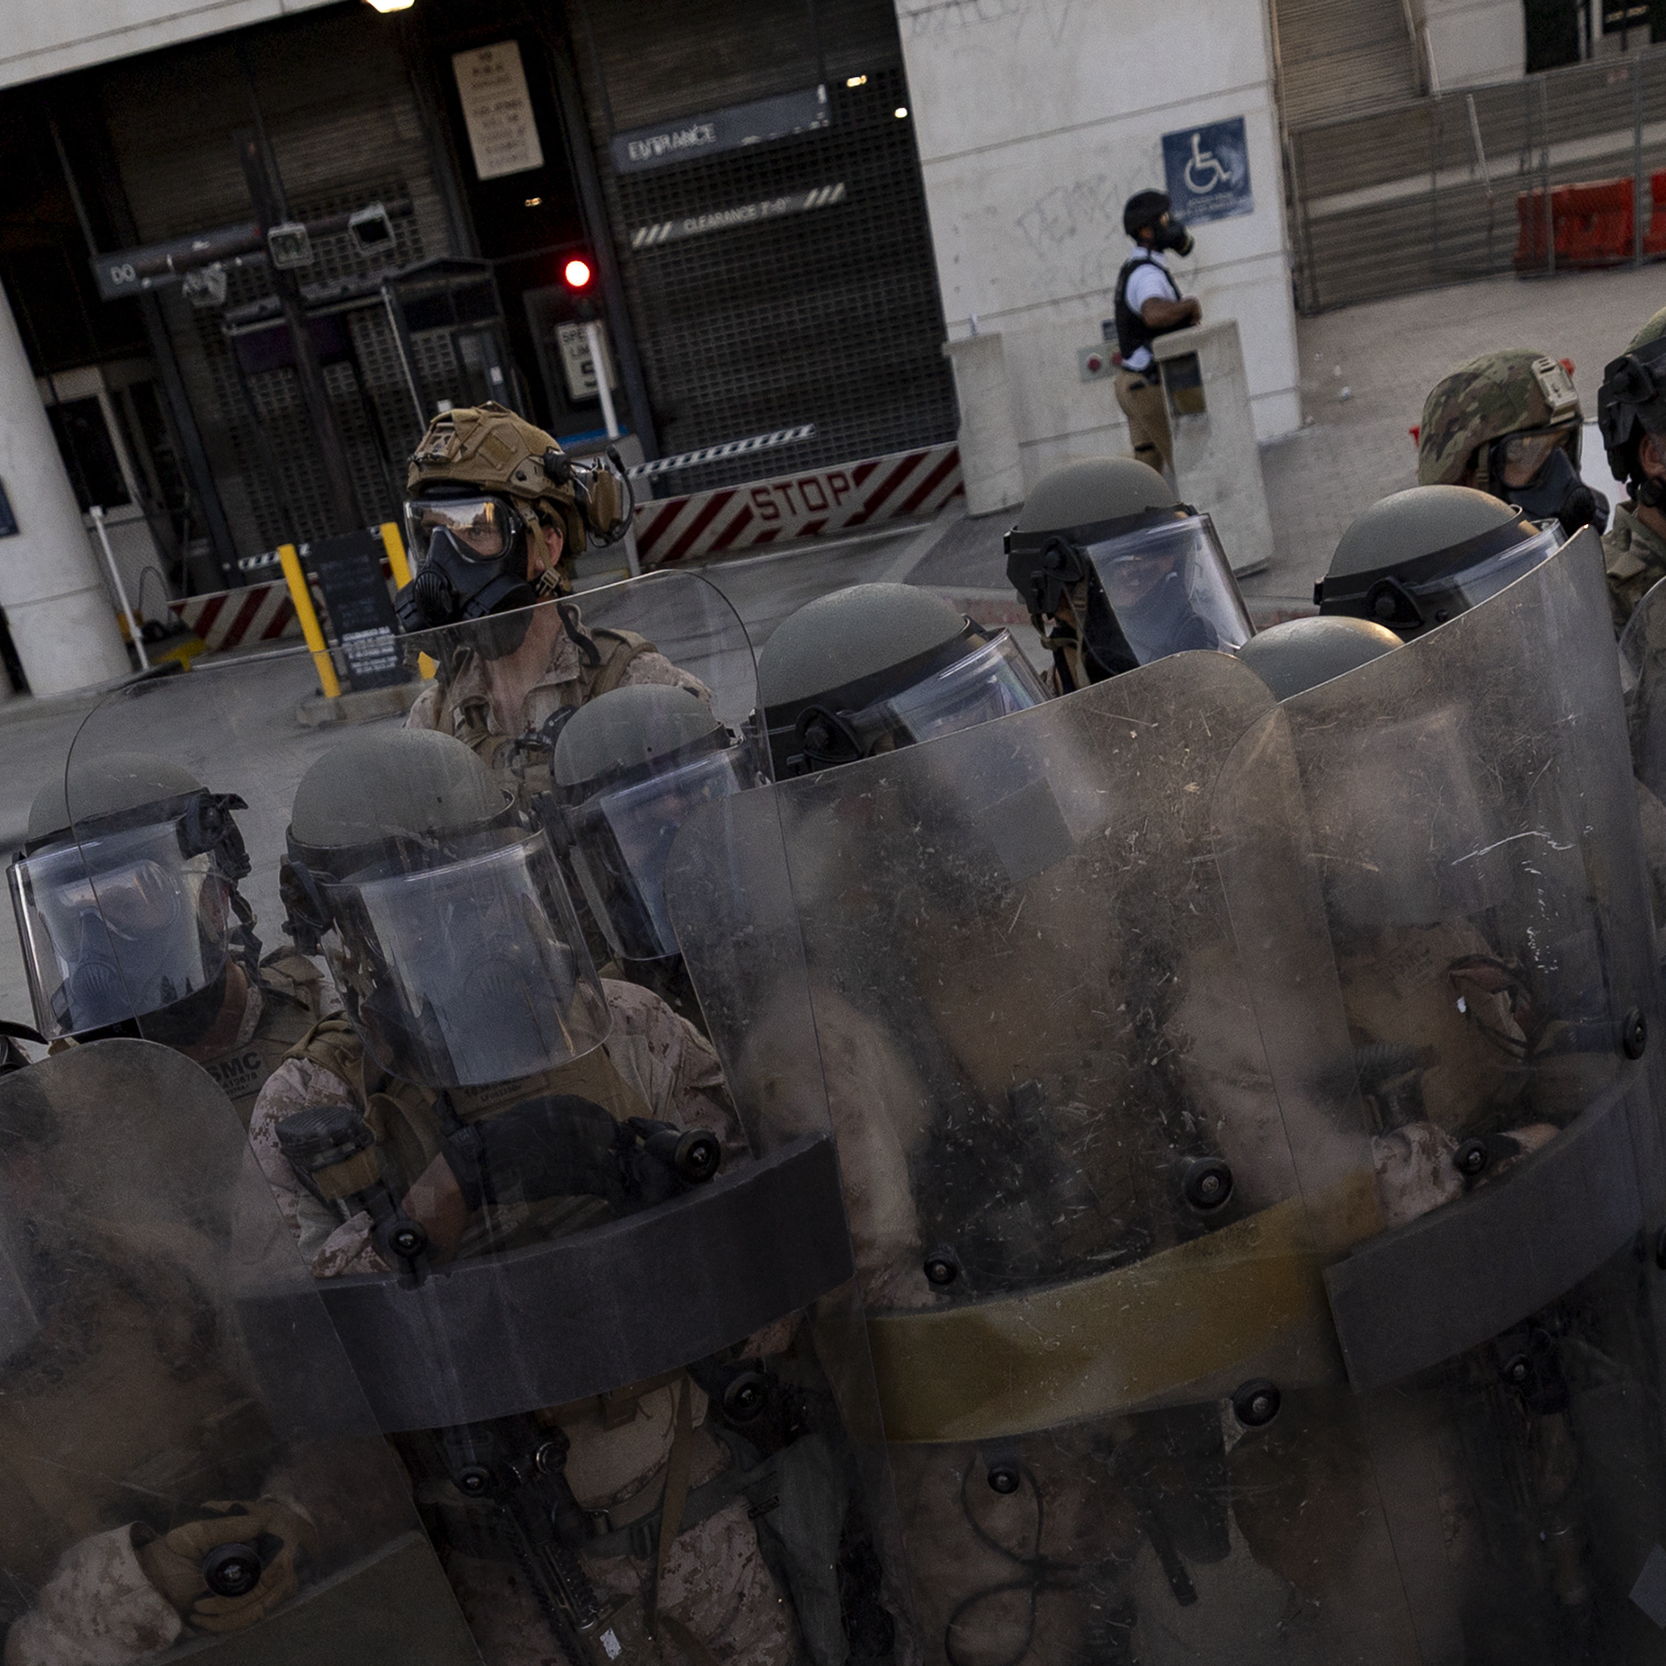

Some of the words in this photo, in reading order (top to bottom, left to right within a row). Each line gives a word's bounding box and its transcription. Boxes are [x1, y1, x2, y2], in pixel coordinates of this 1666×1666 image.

[628, 123, 718, 161] ENTRANCE
[683, 205, 756, 232] CLEARANCE
[562, 327, 587, 343] SPE
[751, 471, 852, 521] STOP
[207, 1052, 261, 1083] SMC
